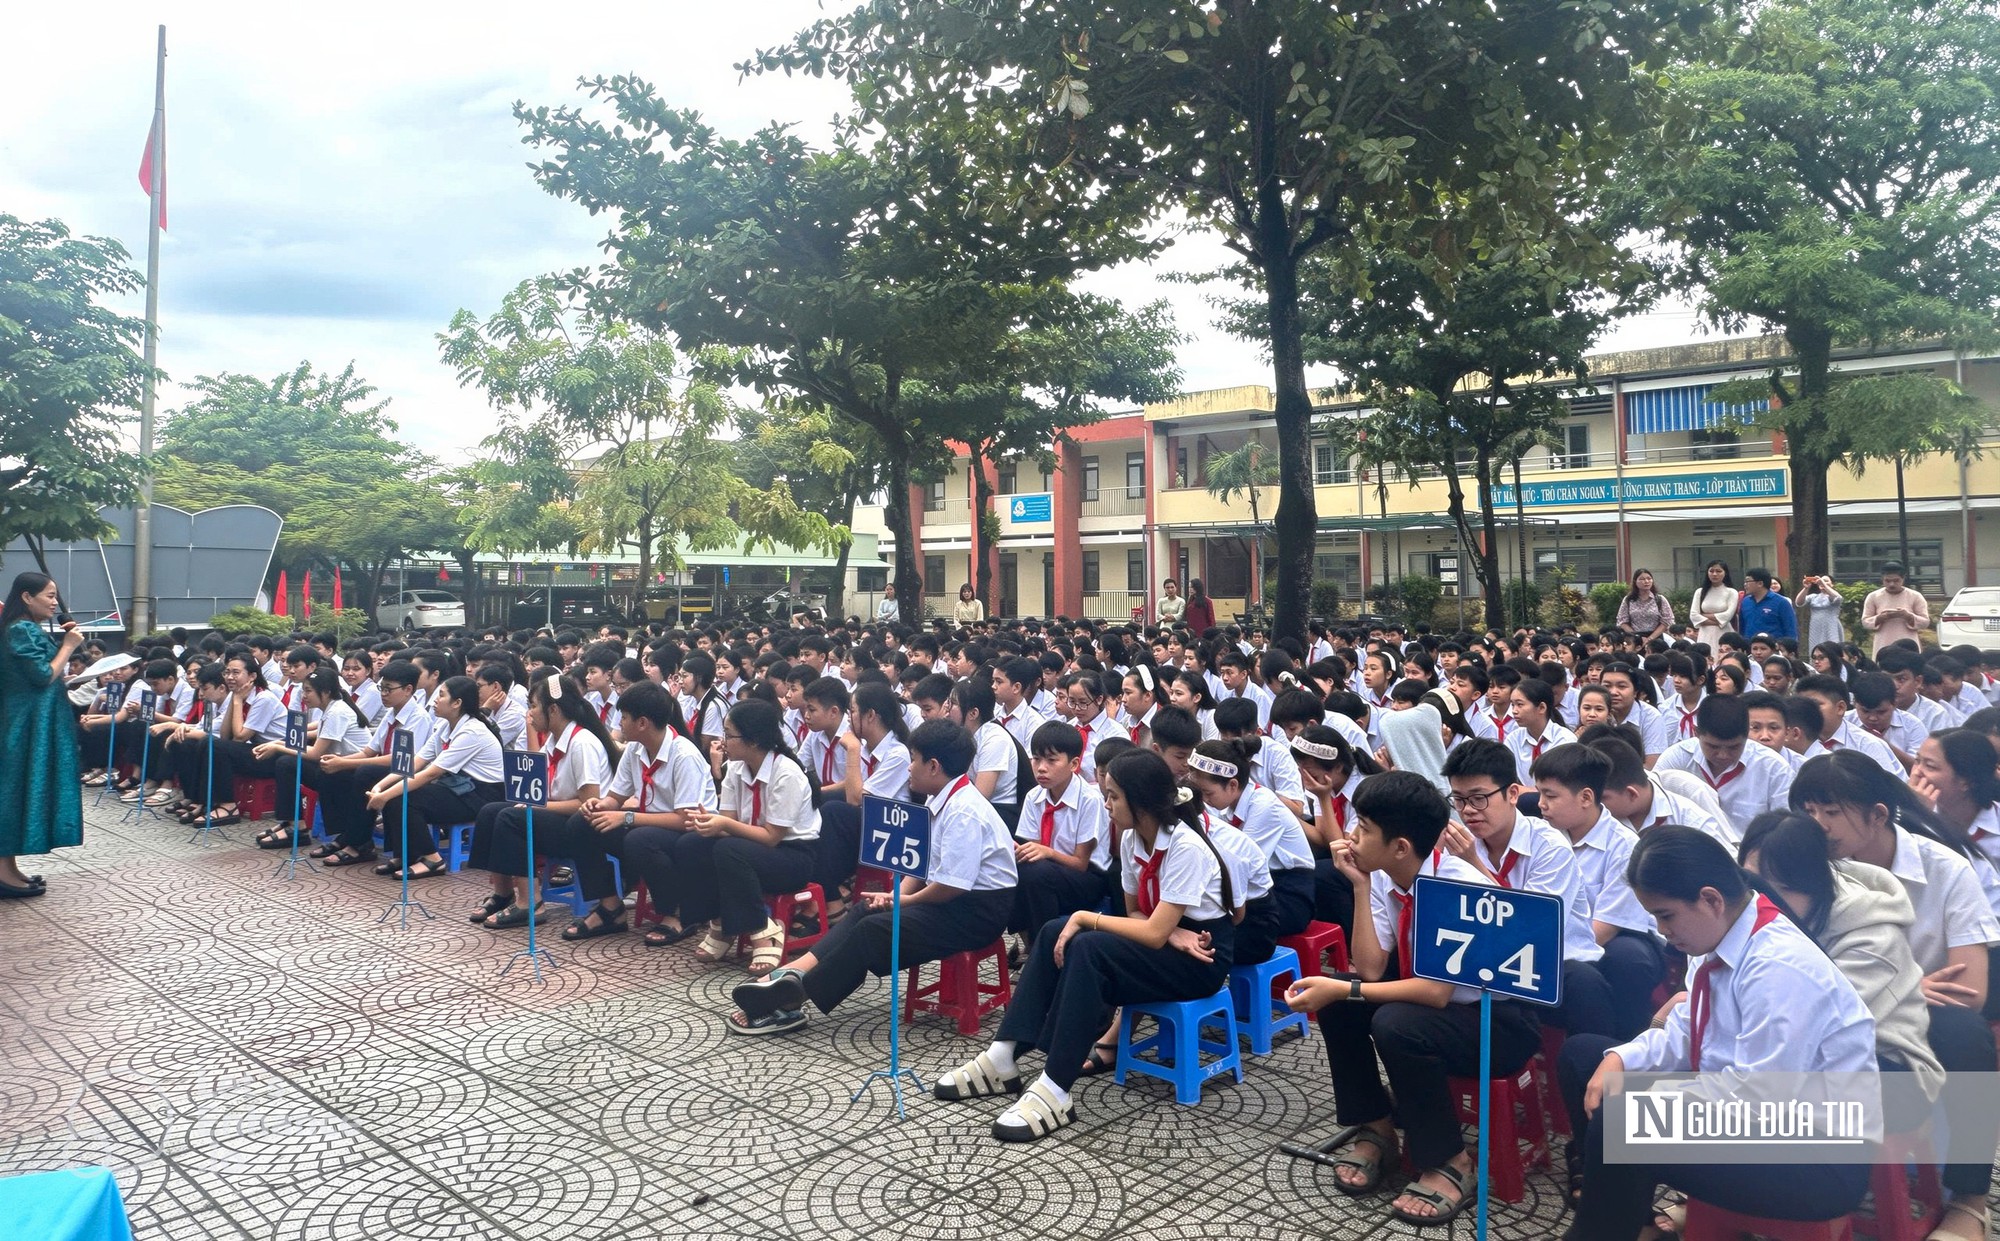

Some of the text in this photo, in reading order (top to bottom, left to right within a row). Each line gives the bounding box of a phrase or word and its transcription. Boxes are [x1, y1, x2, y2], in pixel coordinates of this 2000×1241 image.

[1579, 485, 1606, 500] NGOAN
[1644, 482, 1671, 498] KHANG
[1673, 481, 1700, 496] TRANG
[1748, 474, 1777, 495] THIỆN
[289, 728, 305, 749] 9.1
[396, 751, 412, 773] 7.7
[511, 775, 543, 801] 7.6
[883, 803, 909, 828] LỚP
[872, 829, 920, 870] 7.5
[1459, 891, 1514, 927] LỚP
[1435, 927, 1541, 992] 7.4
